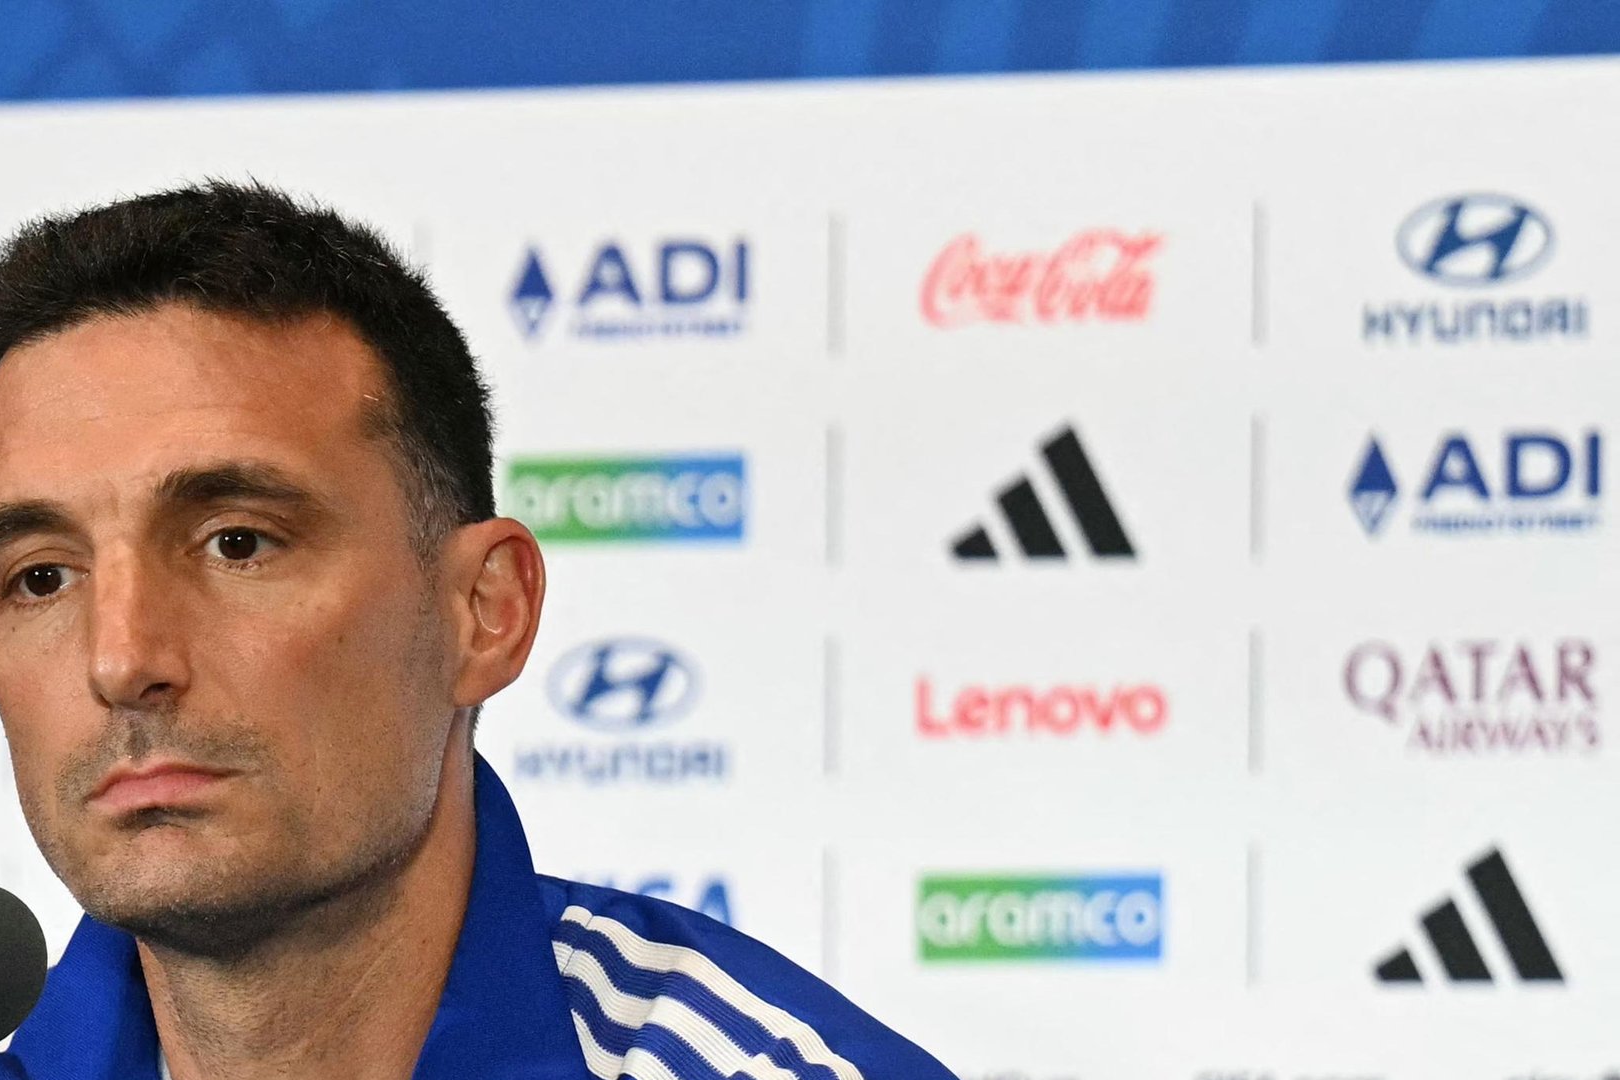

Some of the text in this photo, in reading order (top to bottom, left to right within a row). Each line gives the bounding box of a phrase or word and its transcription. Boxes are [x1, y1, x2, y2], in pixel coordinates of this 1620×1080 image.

[577, 238, 750, 306] ADI
[1362, 299, 1590, 342] HYUNDAI
[1420, 430, 1602, 501] ADI
[508, 472, 743, 529] aramco
[915, 677, 1169, 736] Lenovo
[1342, 639, 1597, 723] QATAR
[1410, 716, 1600, 751] AIRWAYS
[918, 890, 1160, 947] aramco
